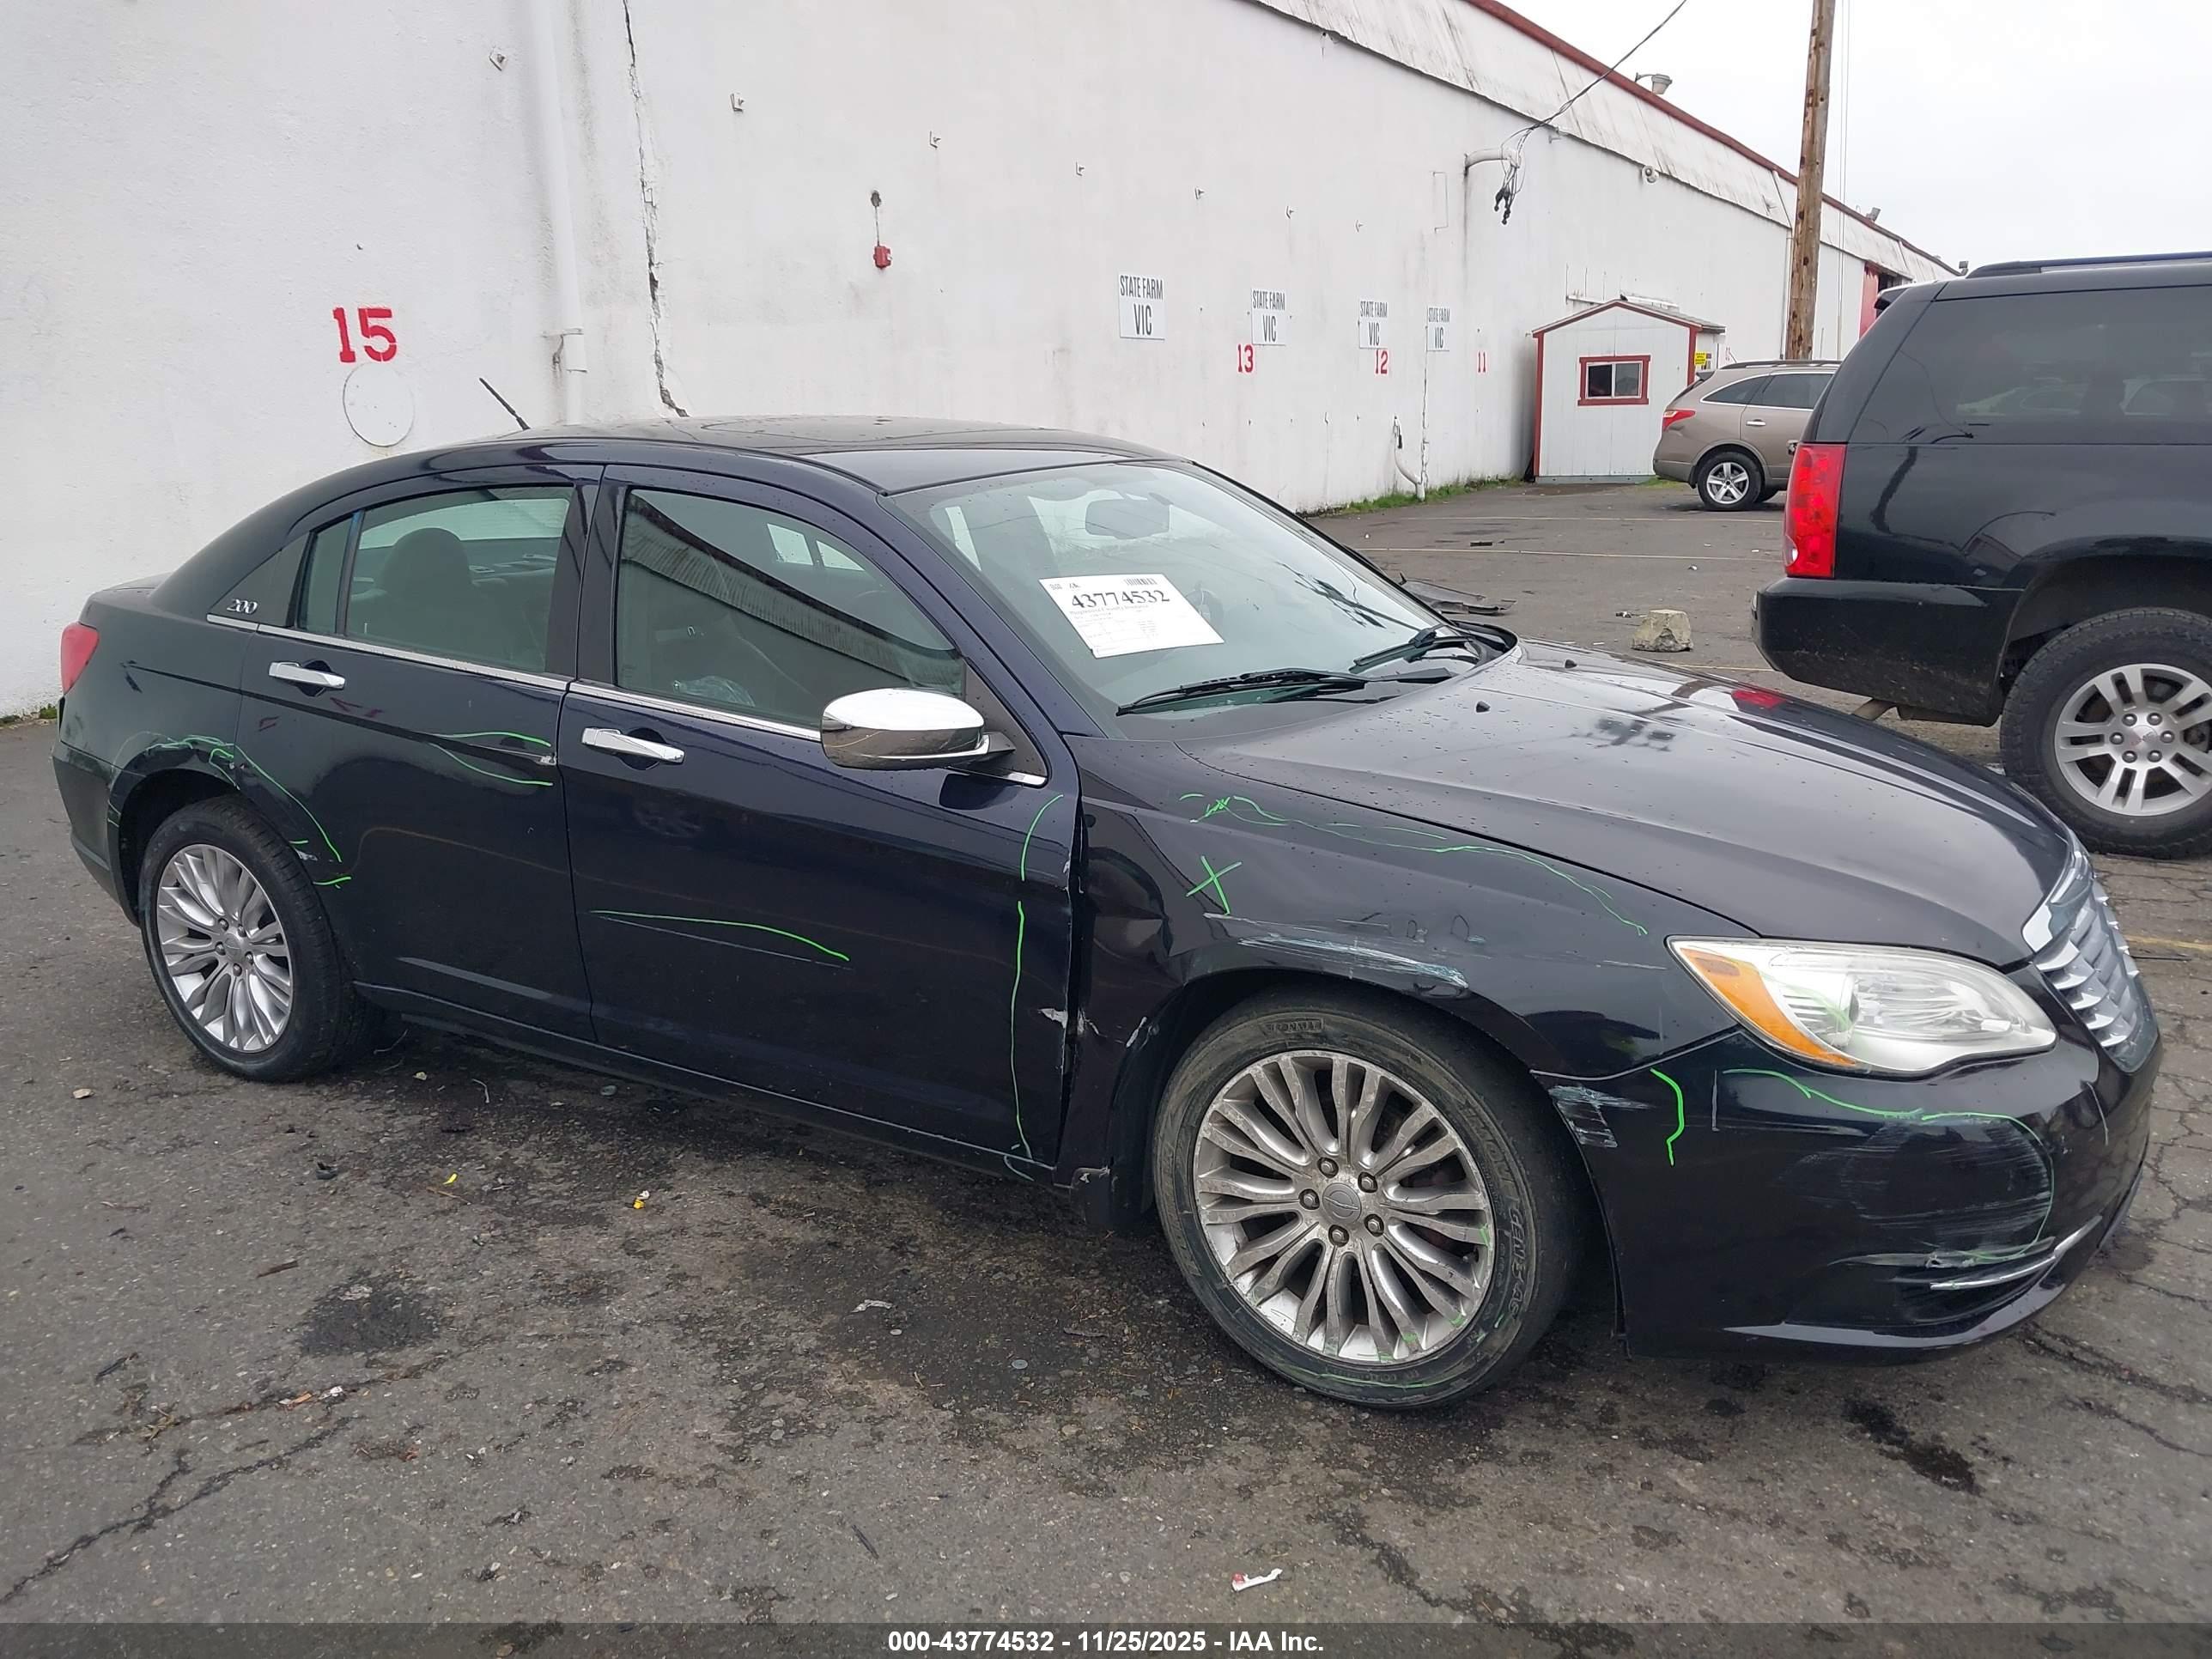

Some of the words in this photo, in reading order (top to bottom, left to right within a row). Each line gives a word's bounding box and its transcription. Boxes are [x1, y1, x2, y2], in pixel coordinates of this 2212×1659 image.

[1120, 275, 1141, 297] STATE
[1142, 277, 1164, 300] FARM
[1252, 289, 1268, 309] STATE
[1269, 291, 1285, 311] FARM
[1360, 301, 1374, 317] STATE
[1374, 301, 1388, 318] FARM
[1133, 303, 1152, 336] VIC
[1428, 307, 1438, 322] STATE
[1438, 307, 1449, 323] FARM
[332, 307, 398, 363] 15
[1262, 314, 1277, 343] VIC
[1368, 322, 1380, 346] VIC
[1434, 326, 1444, 349] VIC
[1237, 344, 1254, 373] 13
[1375, 349, 1389, 374] 12
[1478, 351, 1486, 373] 11
[1071, 590, 1170, 609] 43774532
